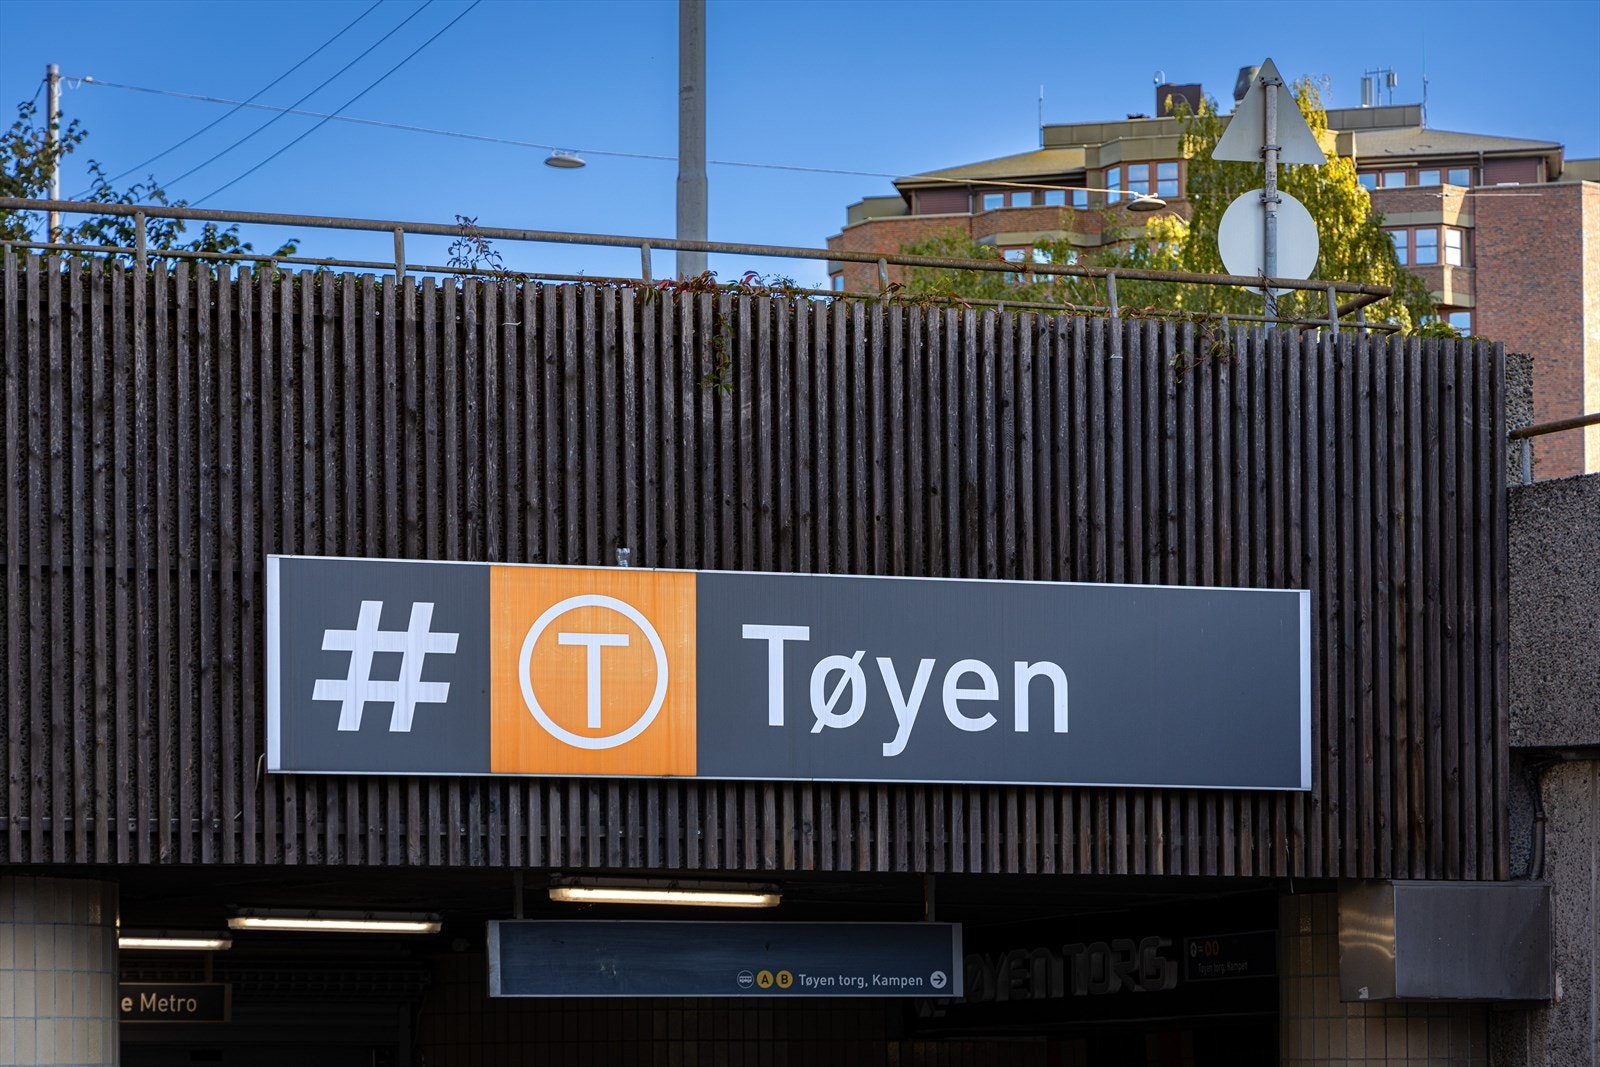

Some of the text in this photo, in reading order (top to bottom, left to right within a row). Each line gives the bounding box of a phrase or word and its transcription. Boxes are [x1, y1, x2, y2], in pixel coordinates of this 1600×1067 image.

[558, 632, 630, 728] T
[741, 623, 1069, 759] Tøyen
[798, 973, 835, 989] Tøyen
[839, 973, 869, 989] torg,
[872, 973, 923, 989] Kampen
[1063, 936, 1178, 996] TORG
[140, 992, 198, 1013] Metro
